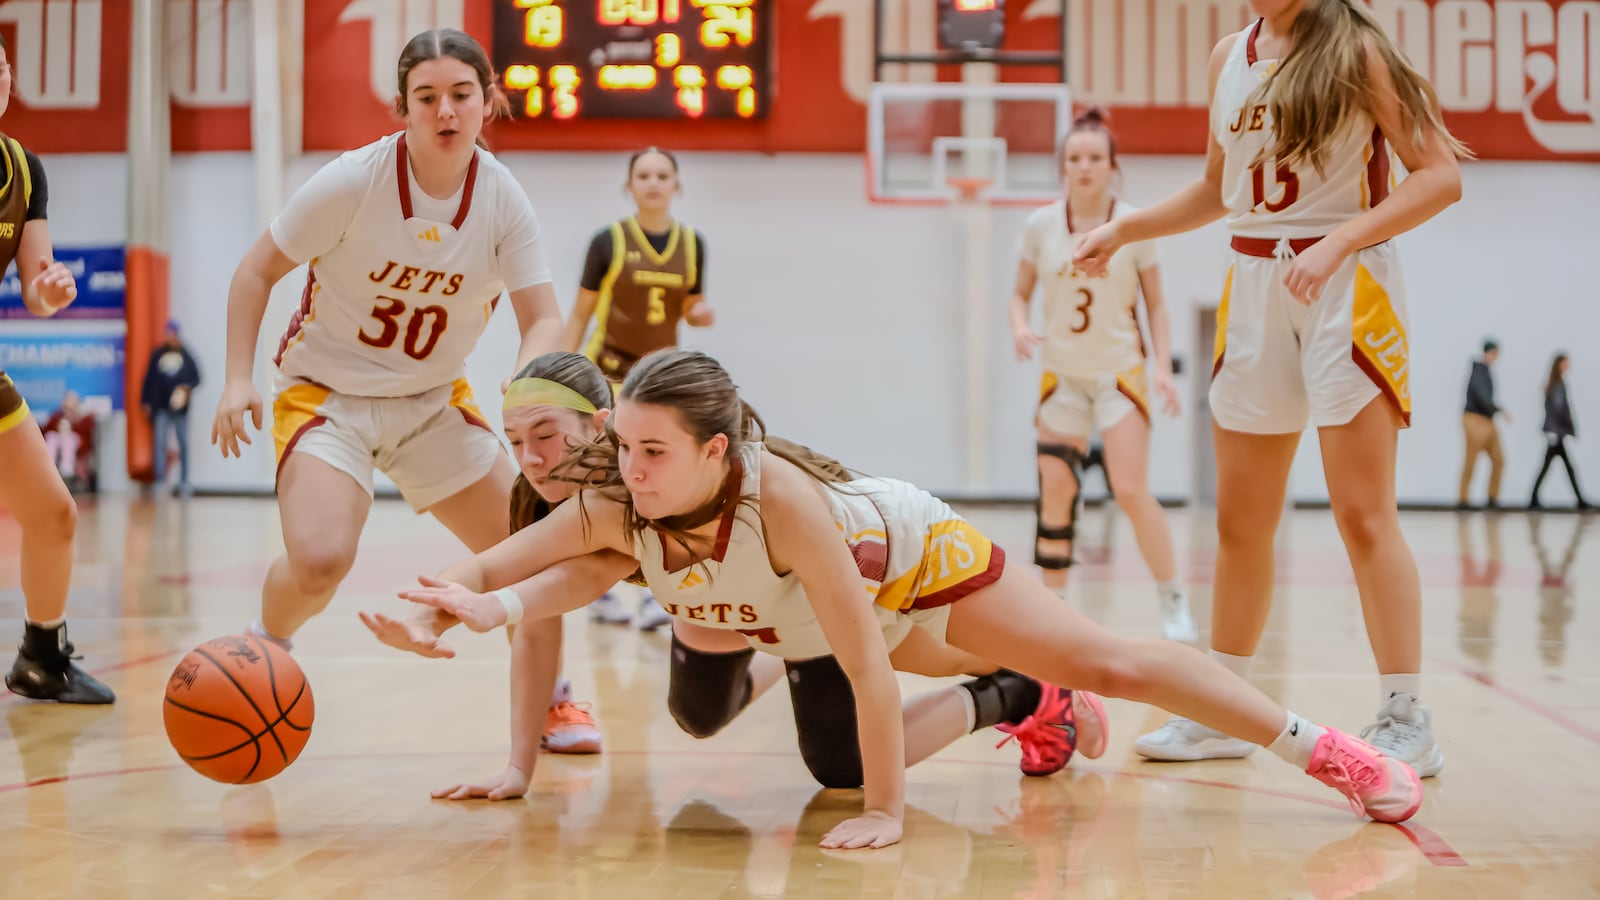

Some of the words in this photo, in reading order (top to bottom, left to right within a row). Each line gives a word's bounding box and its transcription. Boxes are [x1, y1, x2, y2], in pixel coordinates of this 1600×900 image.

[0, 222, 15, 239] RS
[368, 260, 464, 296] JETS
[647, 286, 666, 325] 5
[1070, 287, 1093, 333] 3
[357, 294, 448, 361] 30
[915, 529, 975, 592] TS
[663, 602, 759, 624] JETS
